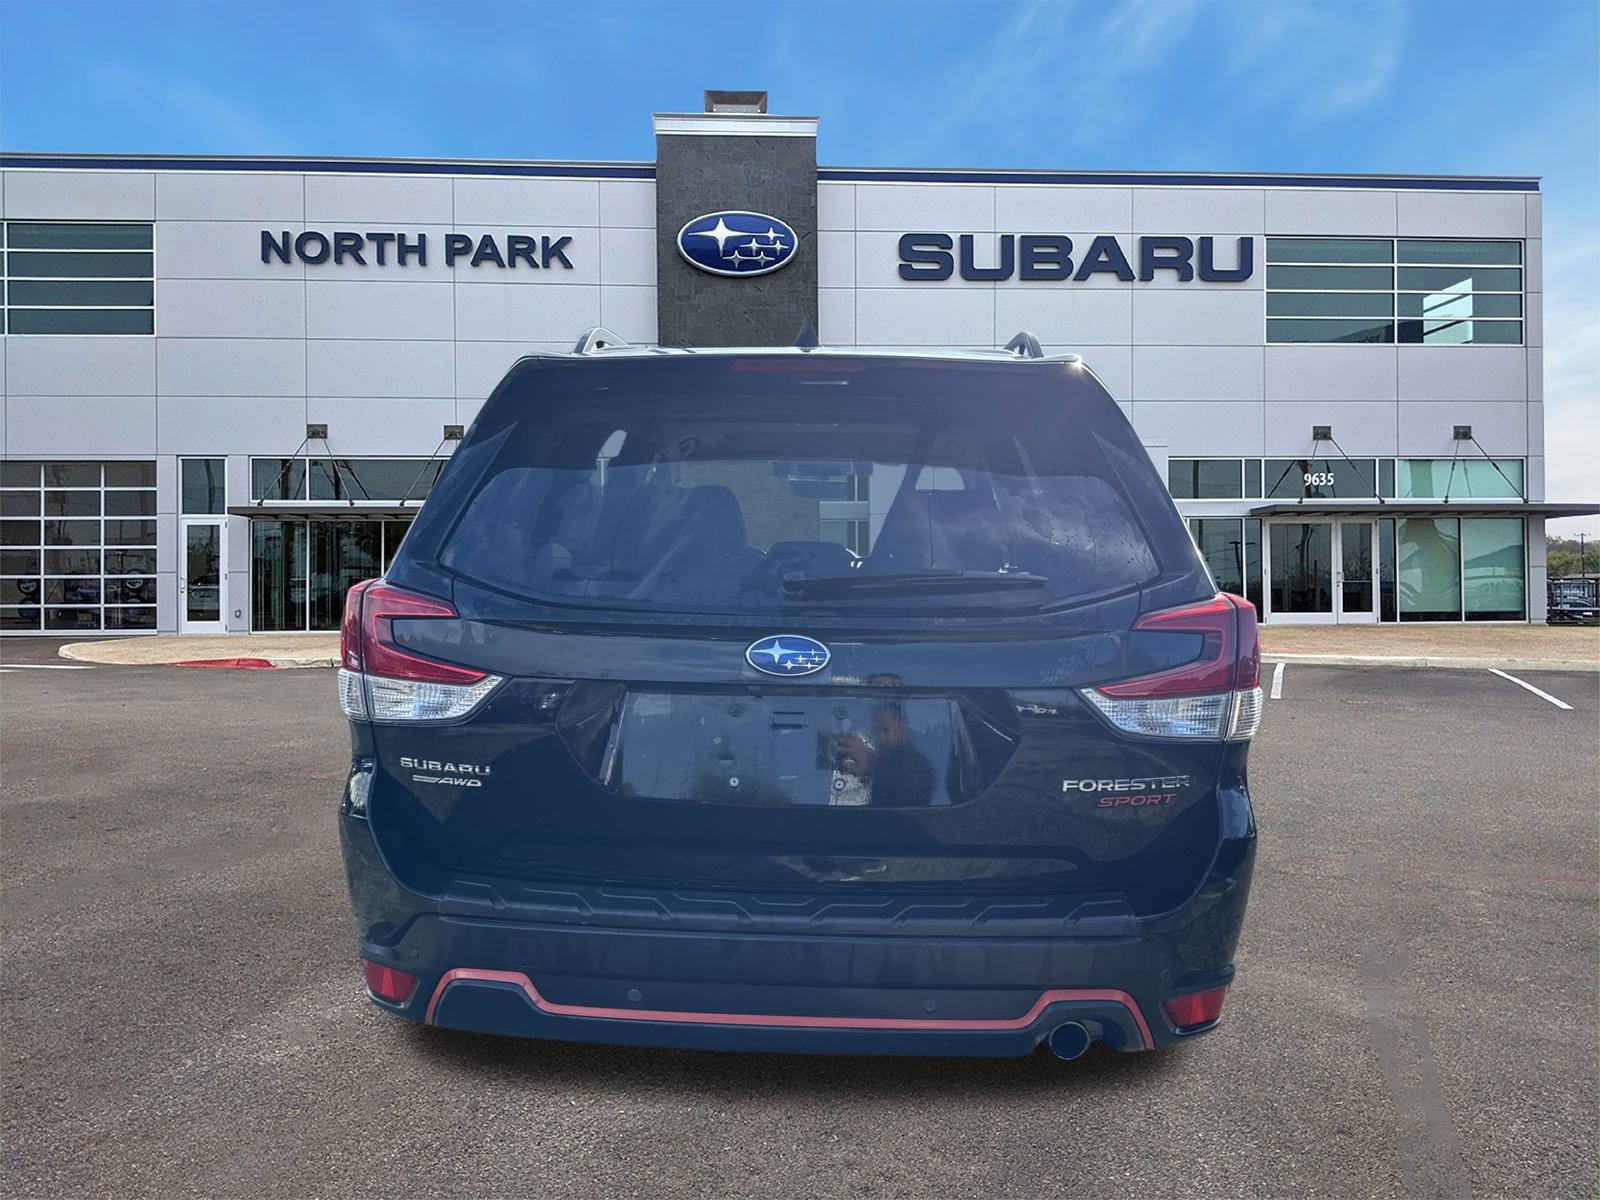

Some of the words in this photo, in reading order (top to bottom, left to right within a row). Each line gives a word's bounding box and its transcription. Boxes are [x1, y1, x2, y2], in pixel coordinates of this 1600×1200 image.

[261, 230, 427, 266] NORTH
[445, 234, 574, 269] PARK
[898, 233, 1254, 282] SUBARU
[1304, 473, 1335, 486] 9635
[400, 757, 491, 776] SUBARU
[1062, 775, 1191, 792] FORESTER
[1099, 793, 1177, 808] SPORT
